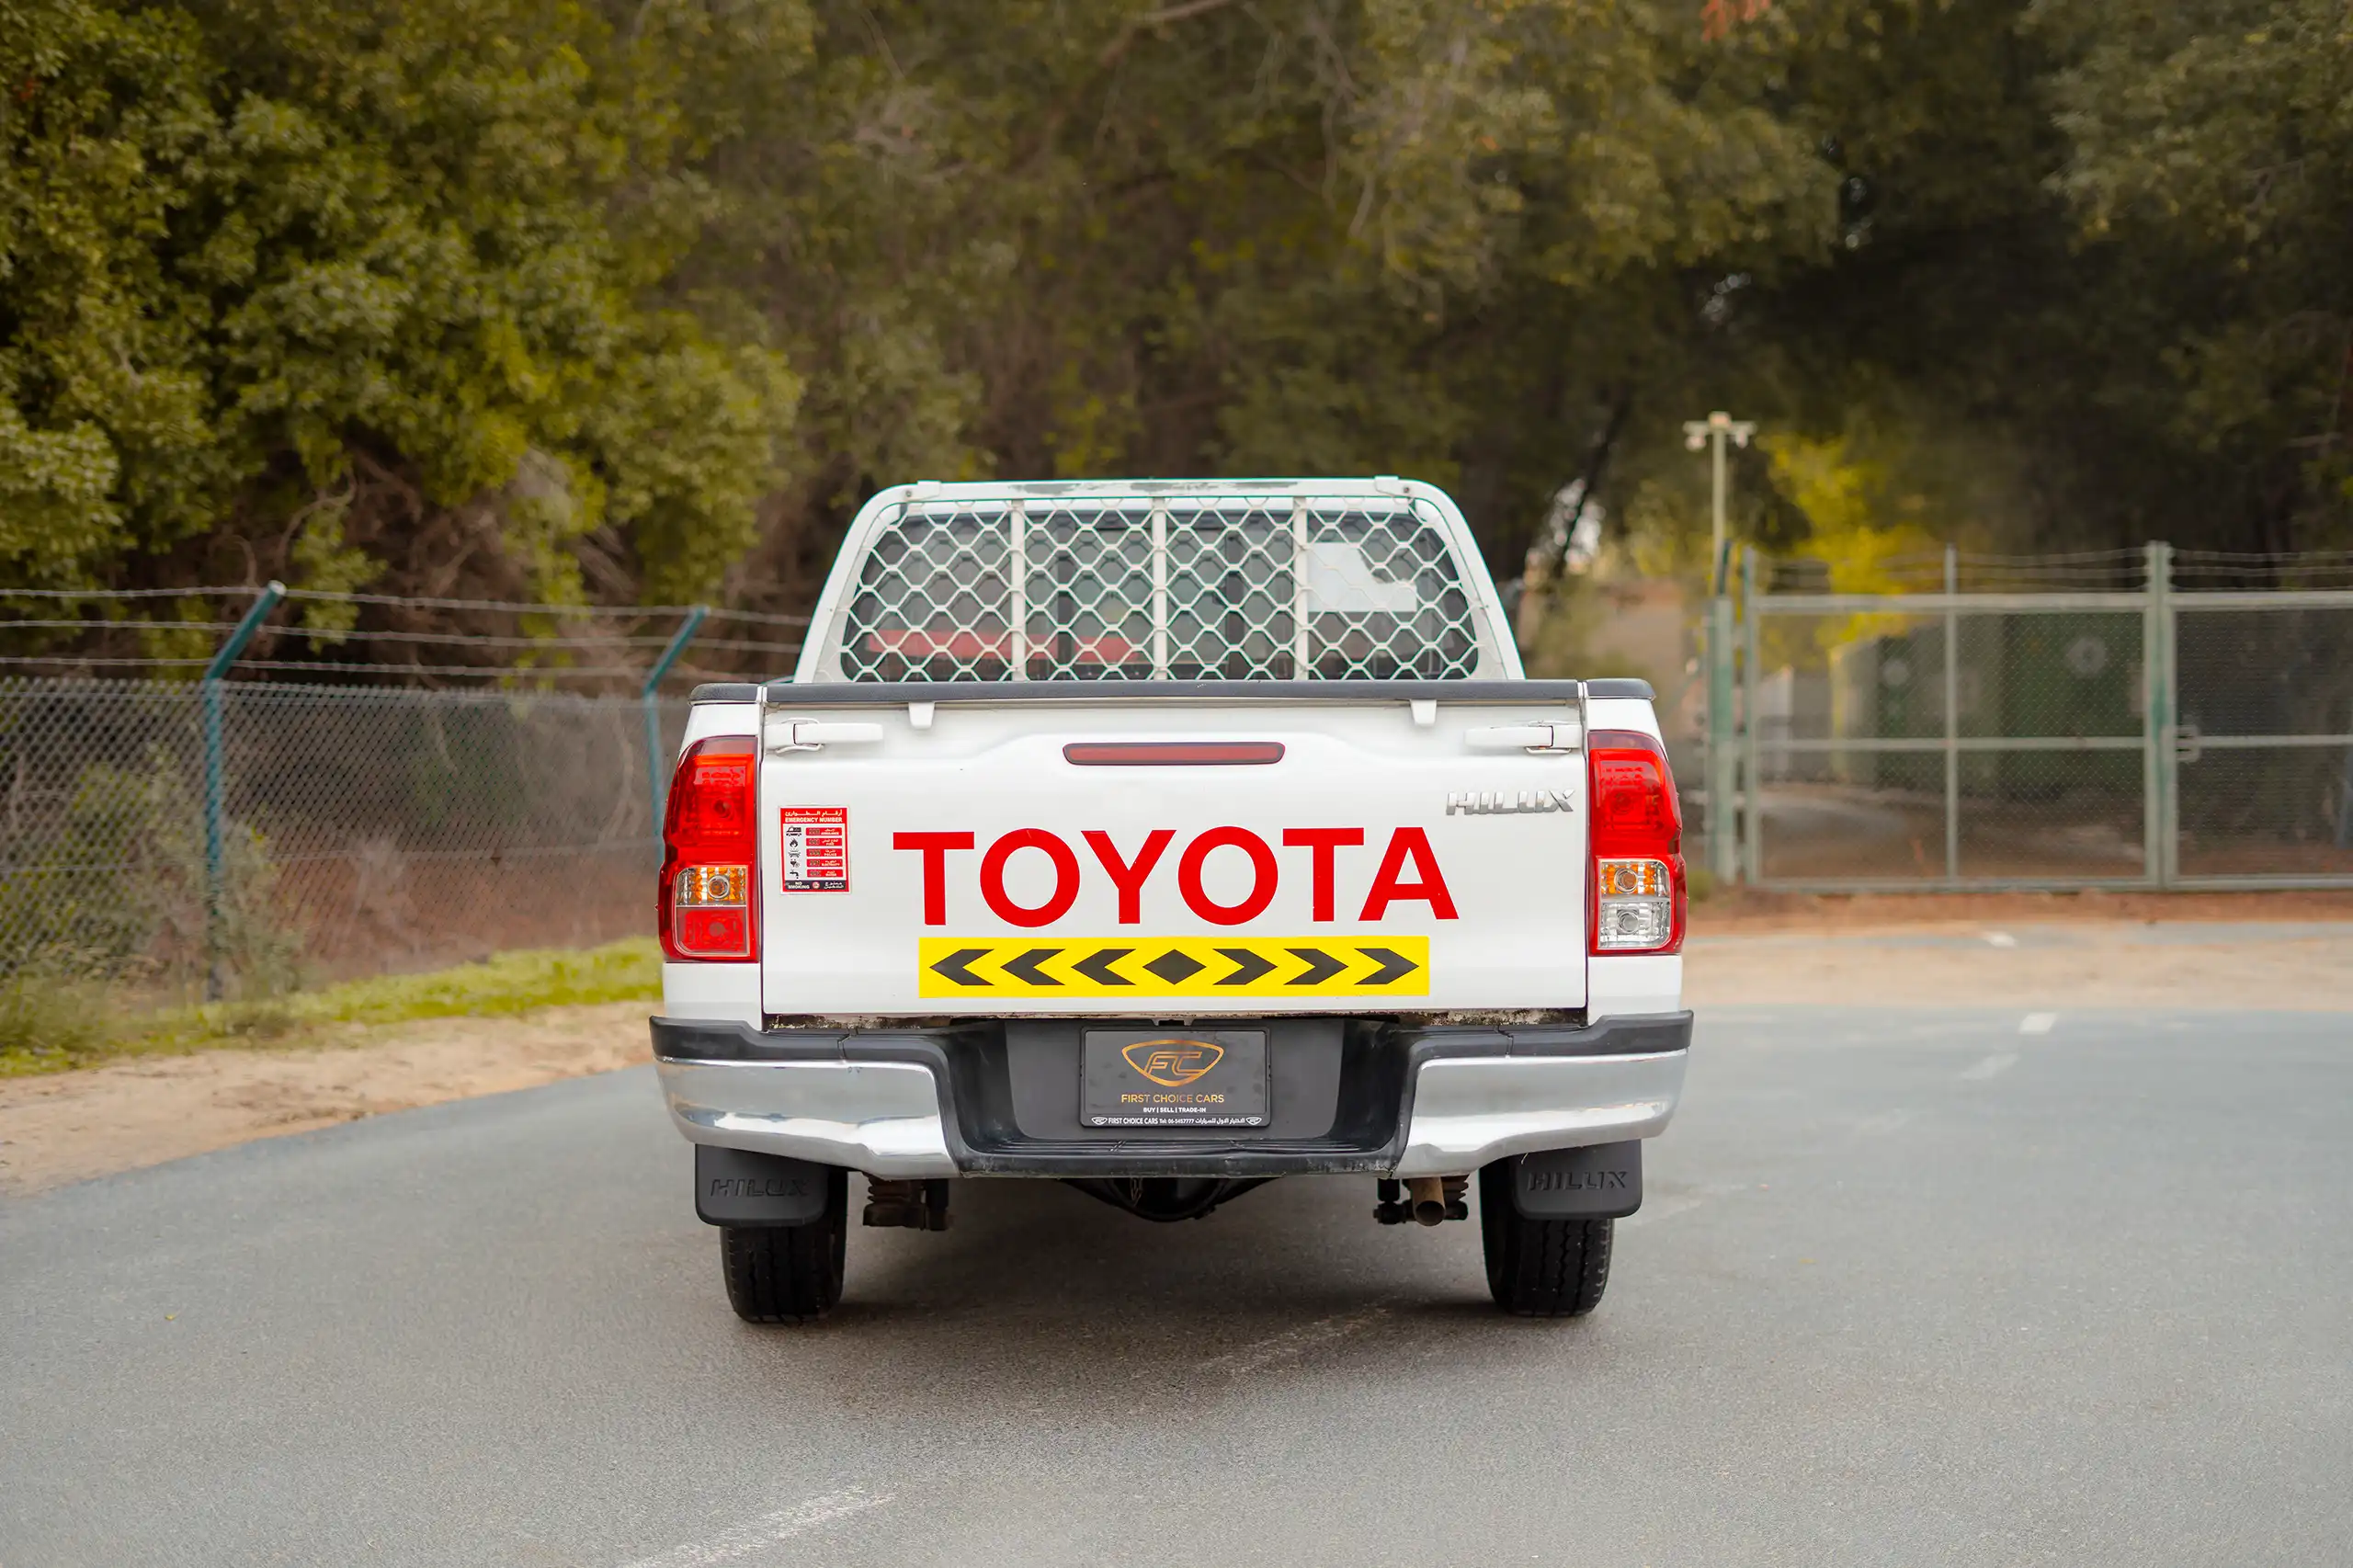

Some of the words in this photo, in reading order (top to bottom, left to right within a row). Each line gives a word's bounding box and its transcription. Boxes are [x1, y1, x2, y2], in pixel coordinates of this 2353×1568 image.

[1446, 790, 1575, 816] HILUX
[892, 826, 1460, 927] TOYOTA
[1121, 1095, 1150, 1103] FIRST
[1153, 1094, 1193, 1103] CHOICE
[1196, 1094, 1225, 1103] CARS
[1123, 1117, 1142, 1125] CHOICE
[710, 1179, 810, 1197] HILUX
[1527, 1171, 1629, 1191] HILUX
